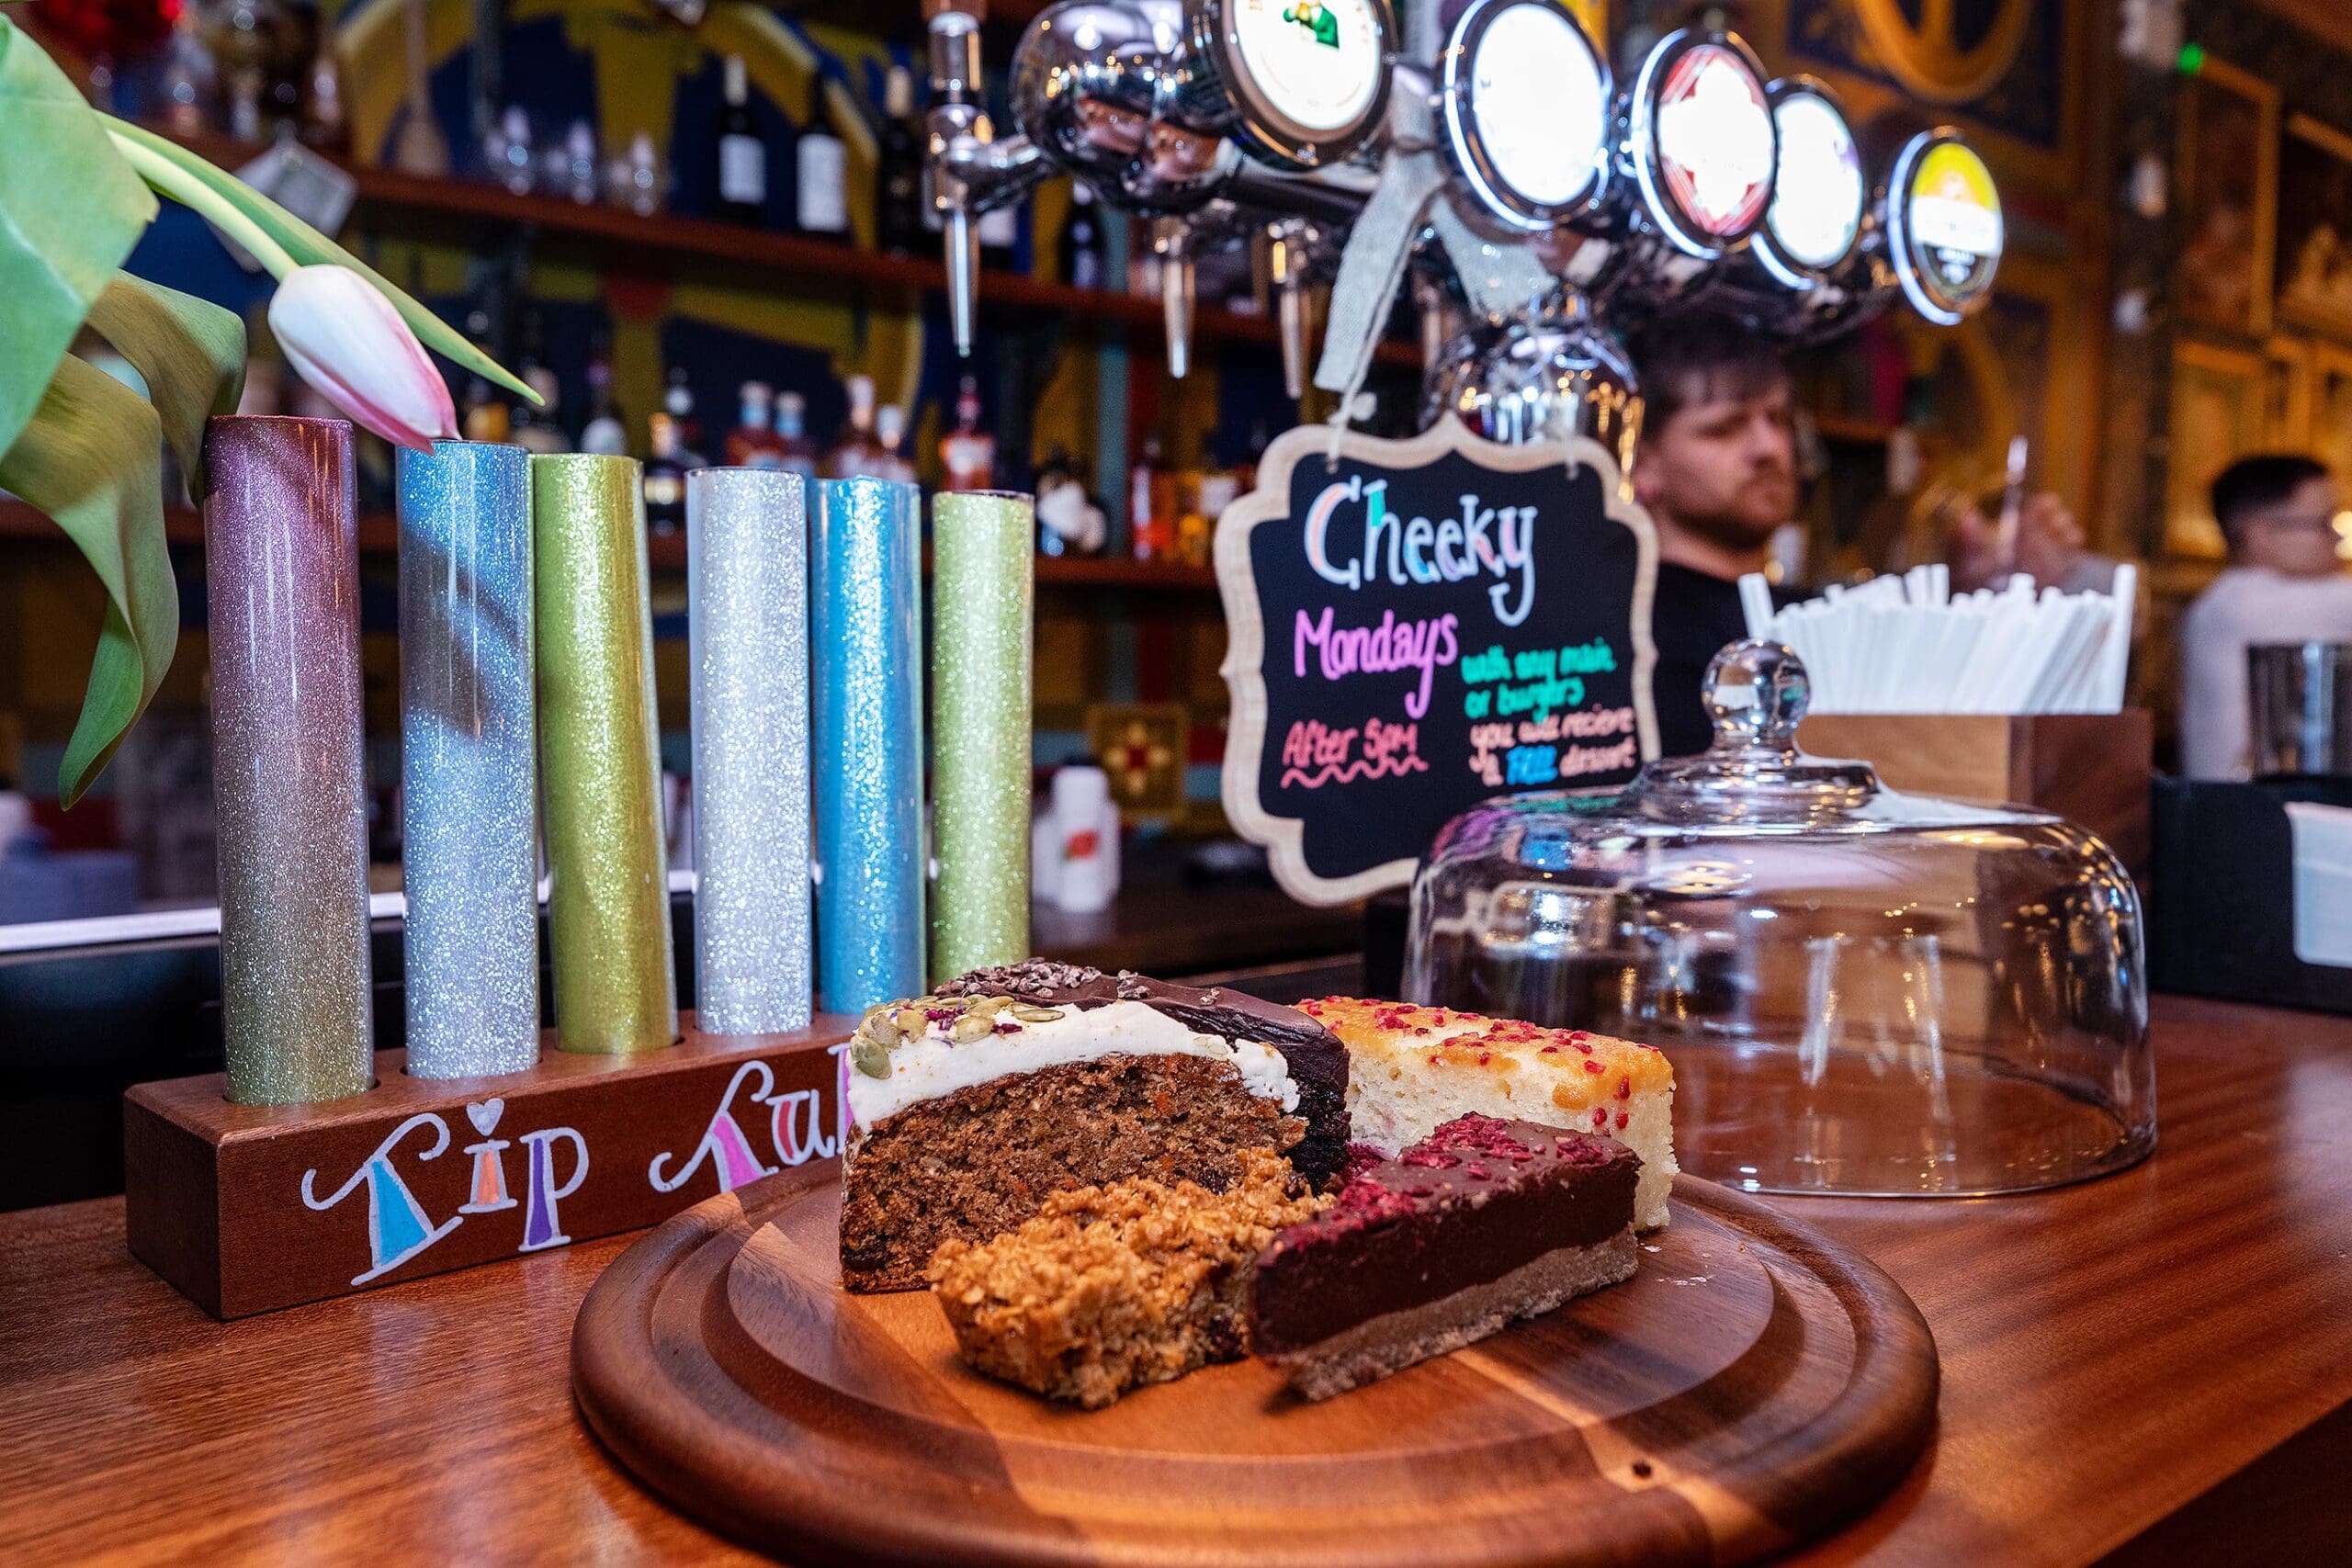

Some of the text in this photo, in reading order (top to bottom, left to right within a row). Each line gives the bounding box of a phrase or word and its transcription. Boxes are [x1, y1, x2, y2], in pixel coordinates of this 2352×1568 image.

[1304, 474, 1539, 626] Cheeky
[1294, 606, 1459, 719] Mondays
[1283, 719, 1359, 768] After
[1464, 690, 1491, 719] or
